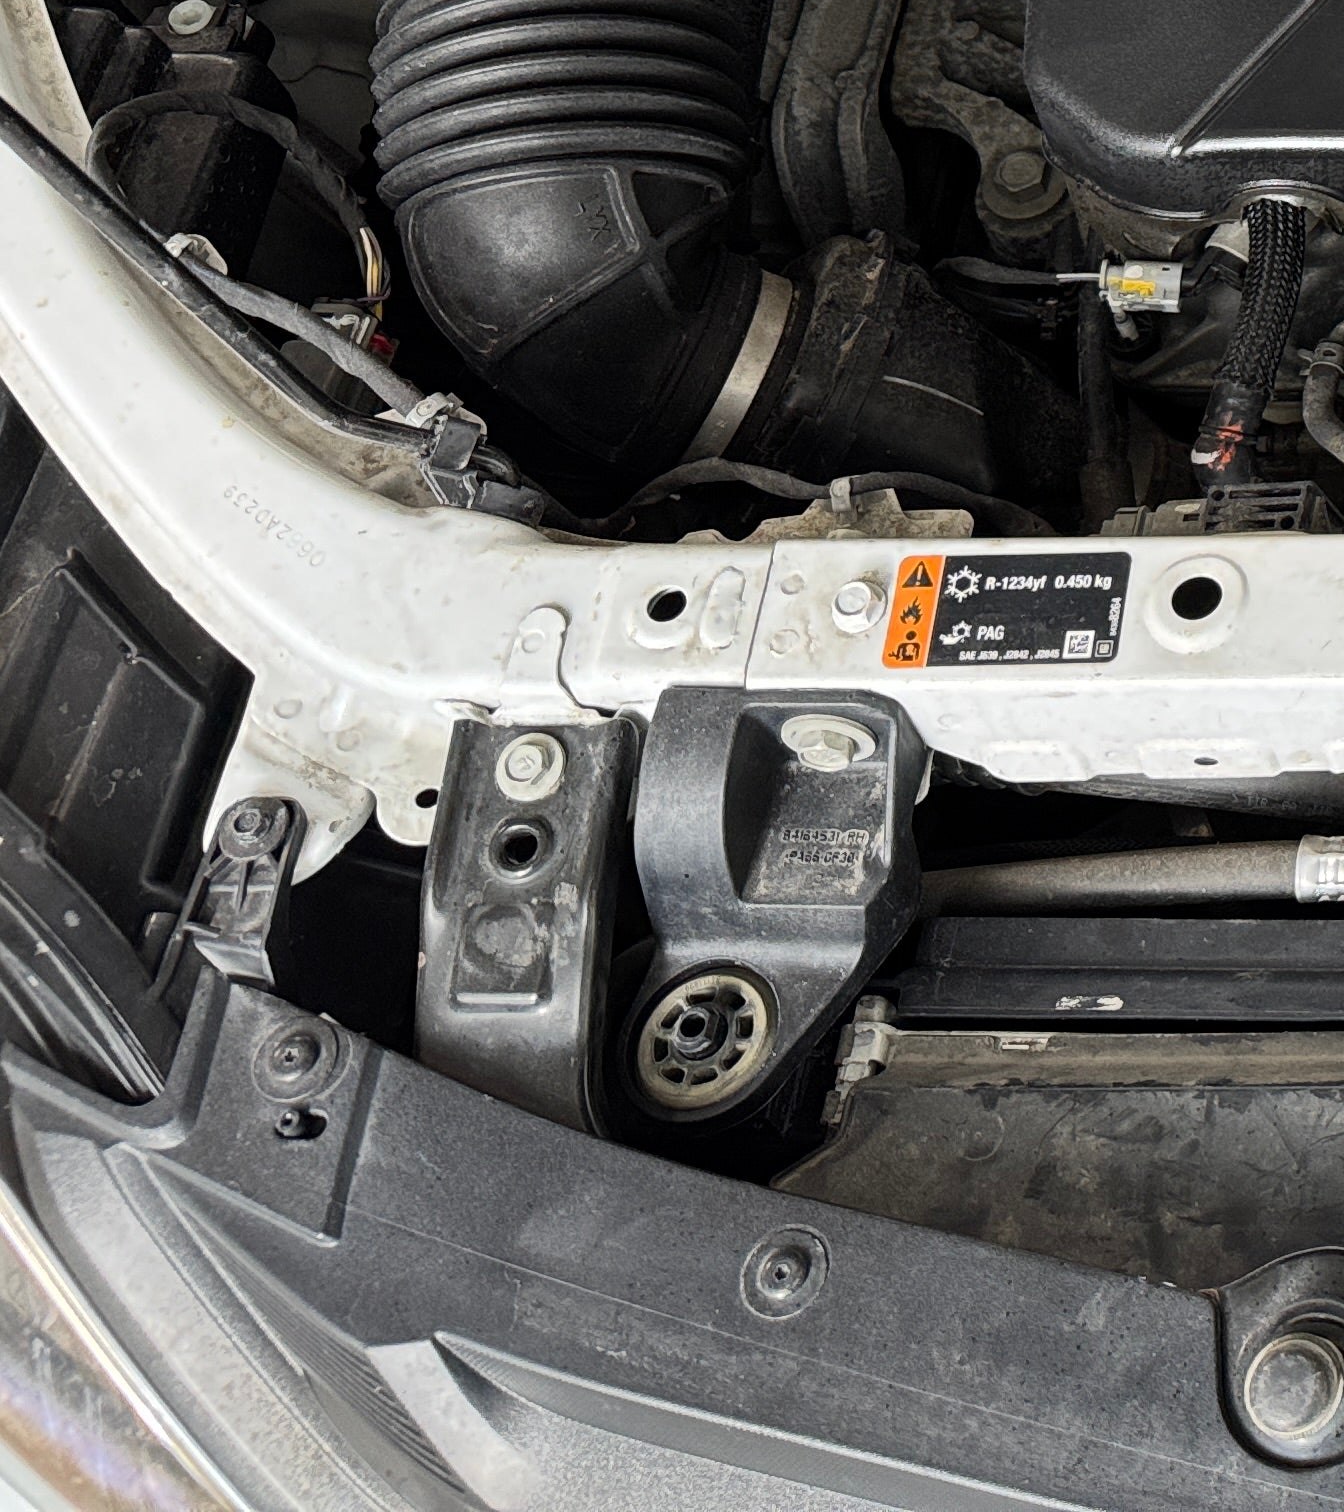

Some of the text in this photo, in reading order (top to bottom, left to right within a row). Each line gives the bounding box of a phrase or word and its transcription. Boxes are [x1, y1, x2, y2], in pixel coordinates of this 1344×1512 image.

[984, 574, 1113, 592] R-1234yf 0.450 kg
[976, 625, 1005, 641] PAG
[959, 651, 977, 661] SAE
[847, 831, 865, 842] RH
